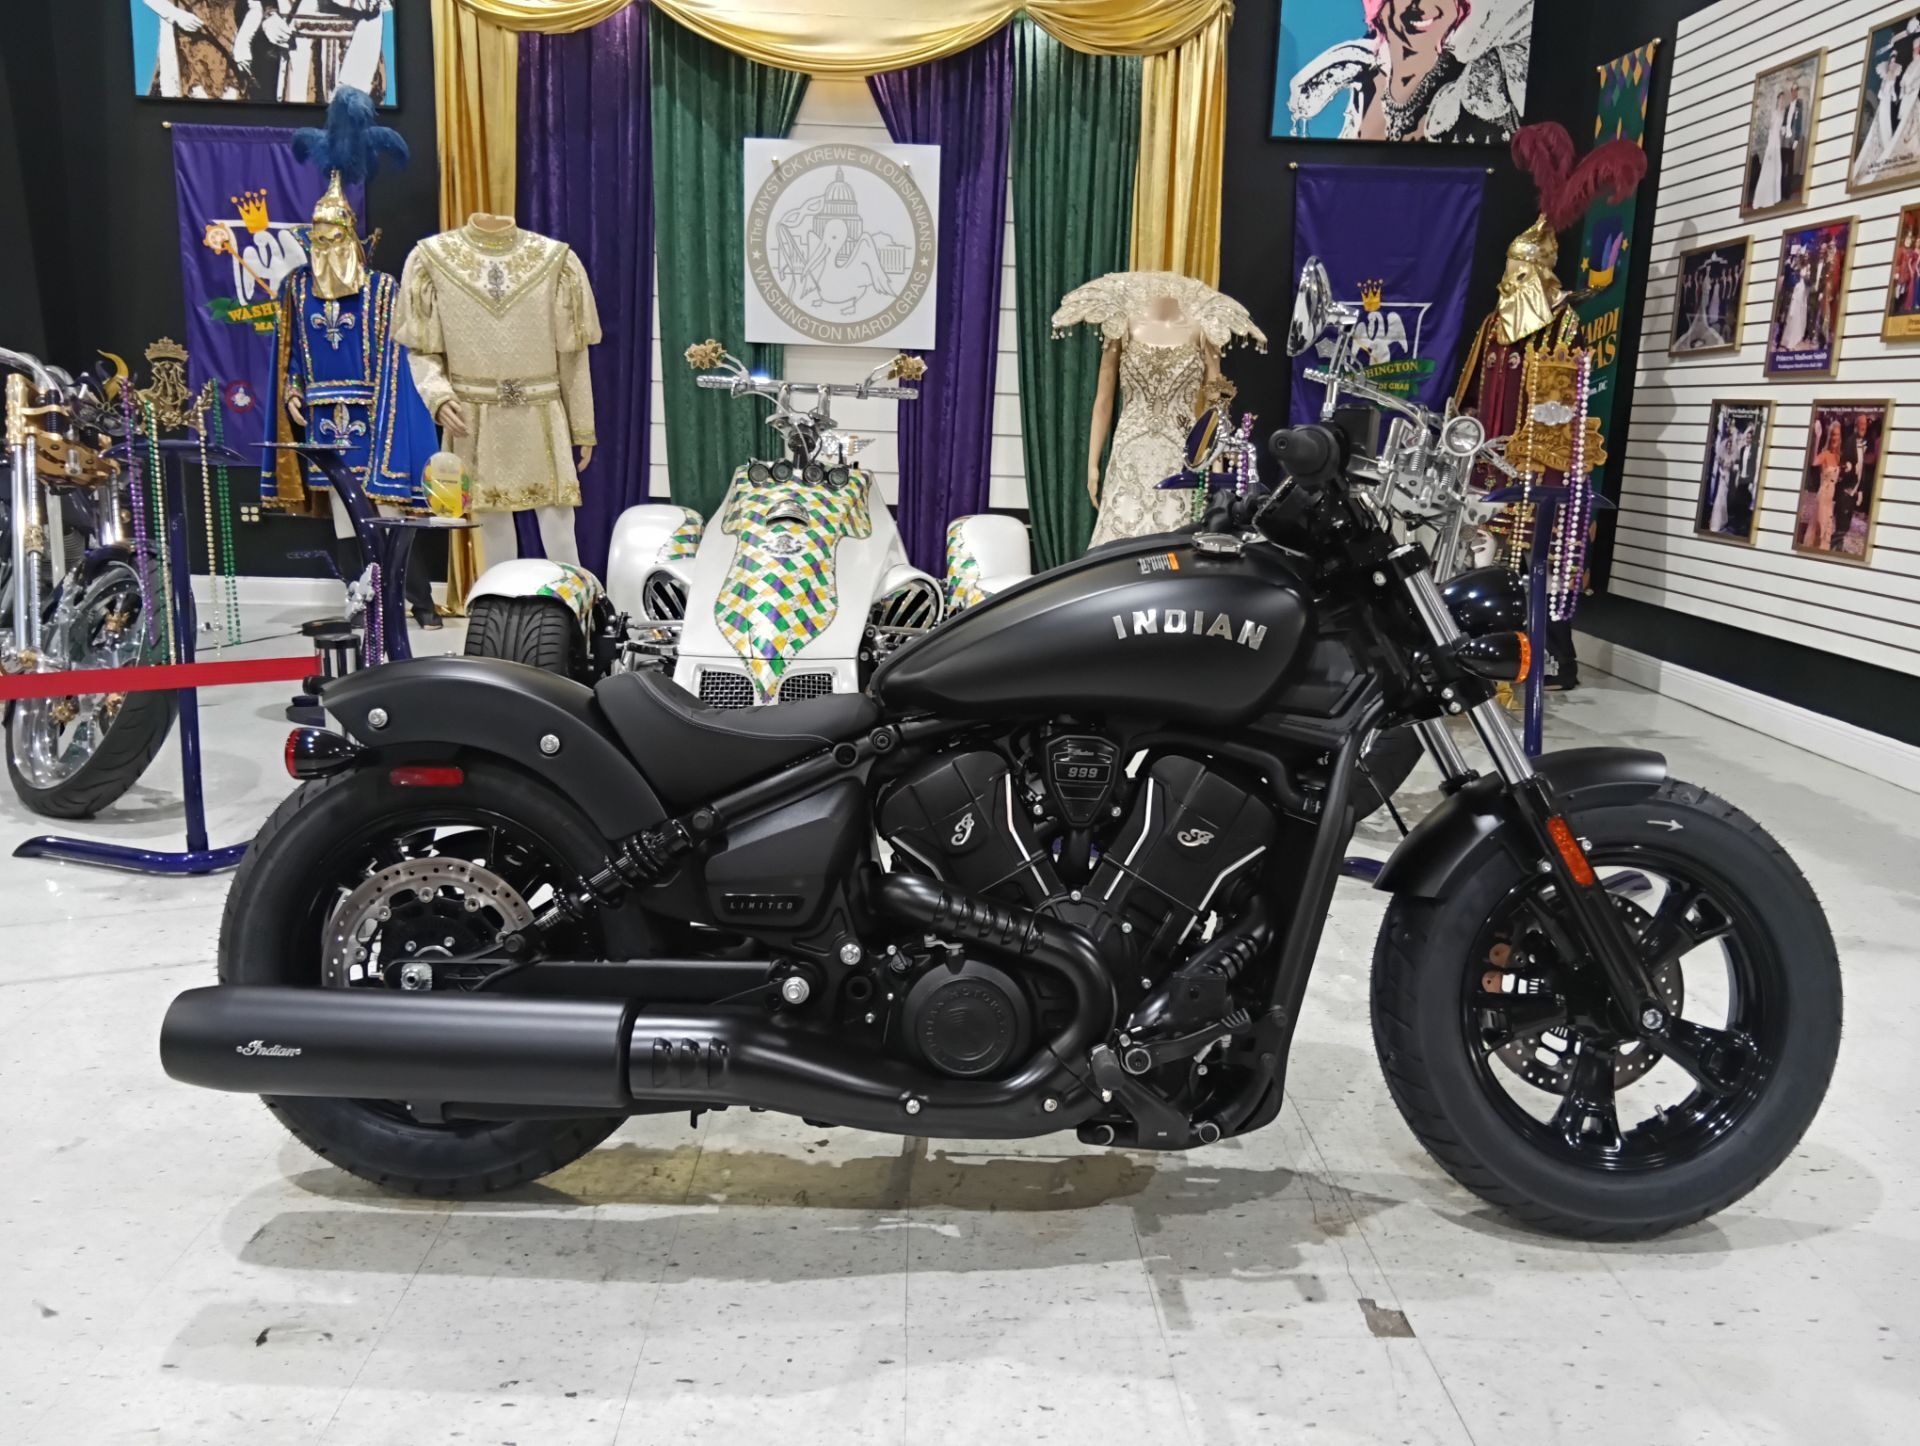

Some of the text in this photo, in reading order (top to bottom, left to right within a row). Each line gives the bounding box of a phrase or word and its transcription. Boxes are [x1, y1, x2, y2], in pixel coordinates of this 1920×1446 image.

[750, 146, 932, 252] The MYSTICK KREWE of LOUISIANIANS
[753, 264, 928, 341] WASHINGTON MARDI GRAS
[1112, 608, 1268, 651] INDIAN
[1067, 767, 1098, 778] 999
[729, 901, 794, 910] LIMITED
[240, 1039, 299, 1057] Indian
